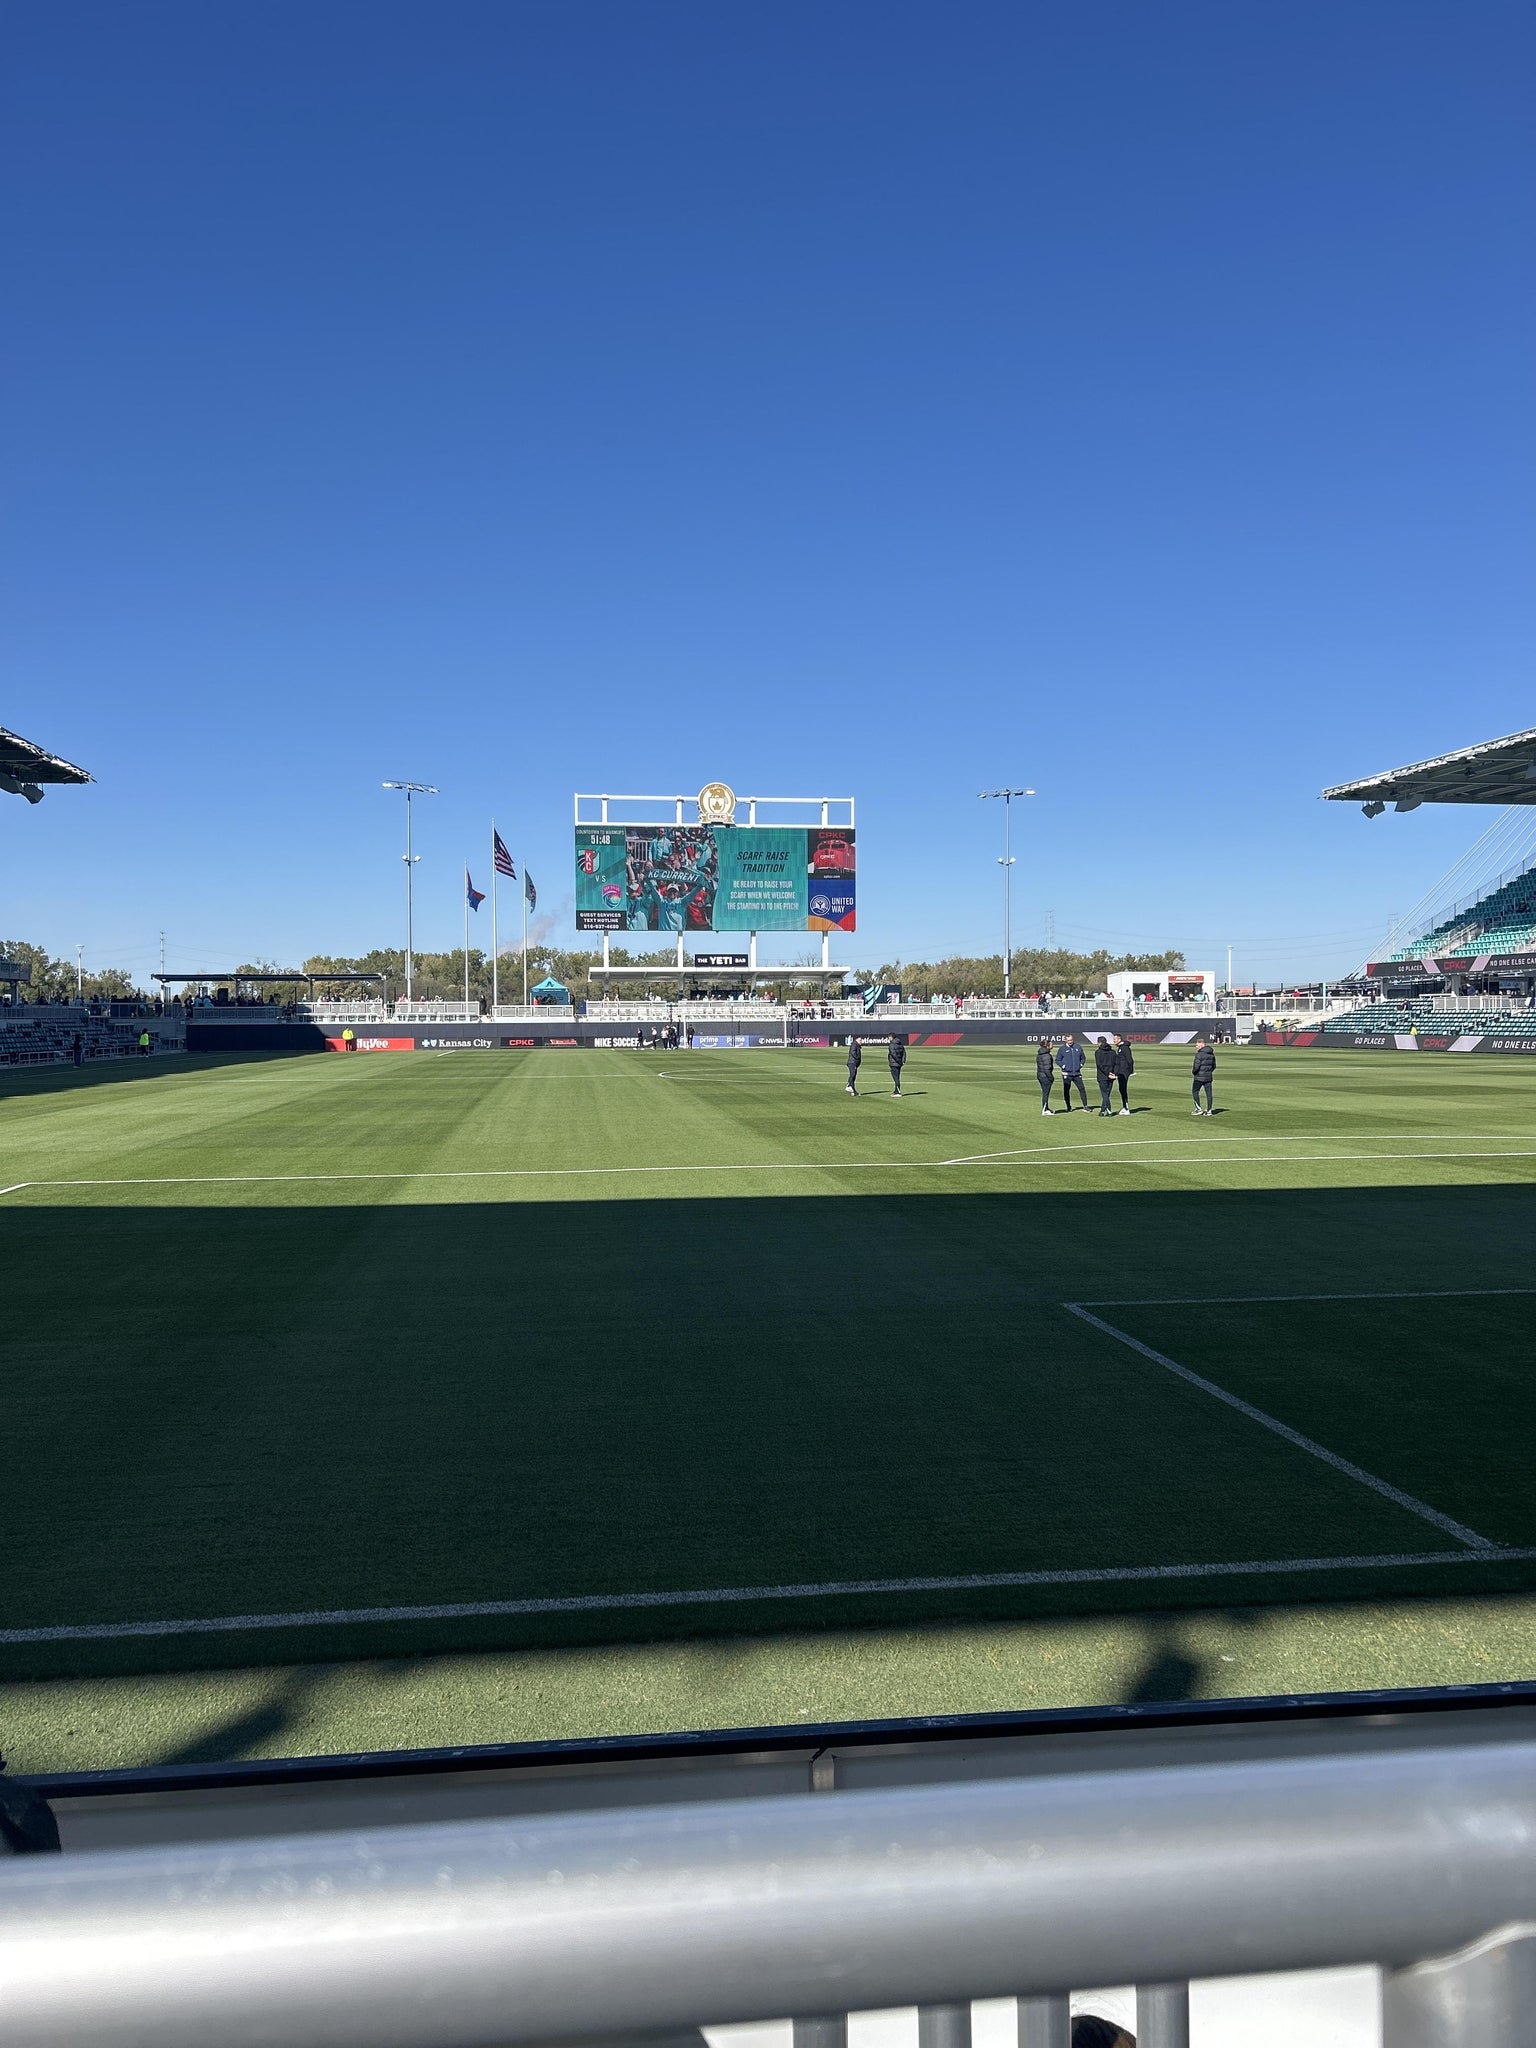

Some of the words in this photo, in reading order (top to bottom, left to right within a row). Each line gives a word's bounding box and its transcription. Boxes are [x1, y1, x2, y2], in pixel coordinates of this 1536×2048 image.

[590, 835, 611, 845] 51:48
[737, 851, 764, 861] SCARF
[765, 851, 790, 861] RAISE
[742, 863, 785, 873] TRADITION
[648, 870, 659, 878] KC
[661, 870, 701, 882] CURRENT
[733, 880, 740, 888] BE
[740, 880, 756, 888] READY
[757, 880, 764, 888] TO
[764, 880, 779, 888] RAISE
[779, 880, 793, 888] YOUR
[730, 891, 747, 899] SCARF
[747, 891, 762, 899] WHEN
[763, 891, 771, 899] WE
[771, 891, 795, 899] WELCOME
[831, 897, 854, 905] UNITED
[727, 902, 736, 910] THE
[736, 902, 760, 910] STARTING
[831, 905, 845, 913] WAY
[1511, 958, 1526, 966] ELSE
[594, 1037, 612, 1047] NIKE
[1126, 1034, 1157, 1042] CPKC
[1354, 1037, 1363, 1045] GO
[1363, 1037, 1386, 1045] PLACES
[438, 1039, 472, 1047] Kansas
[473, 1038, 492, 1048] City
[1423, 1038, 1448, 1048] CPKC
[1491, 1040, 1503, 1049] NO
[1504, 1040, 1521, 1049] ONE
